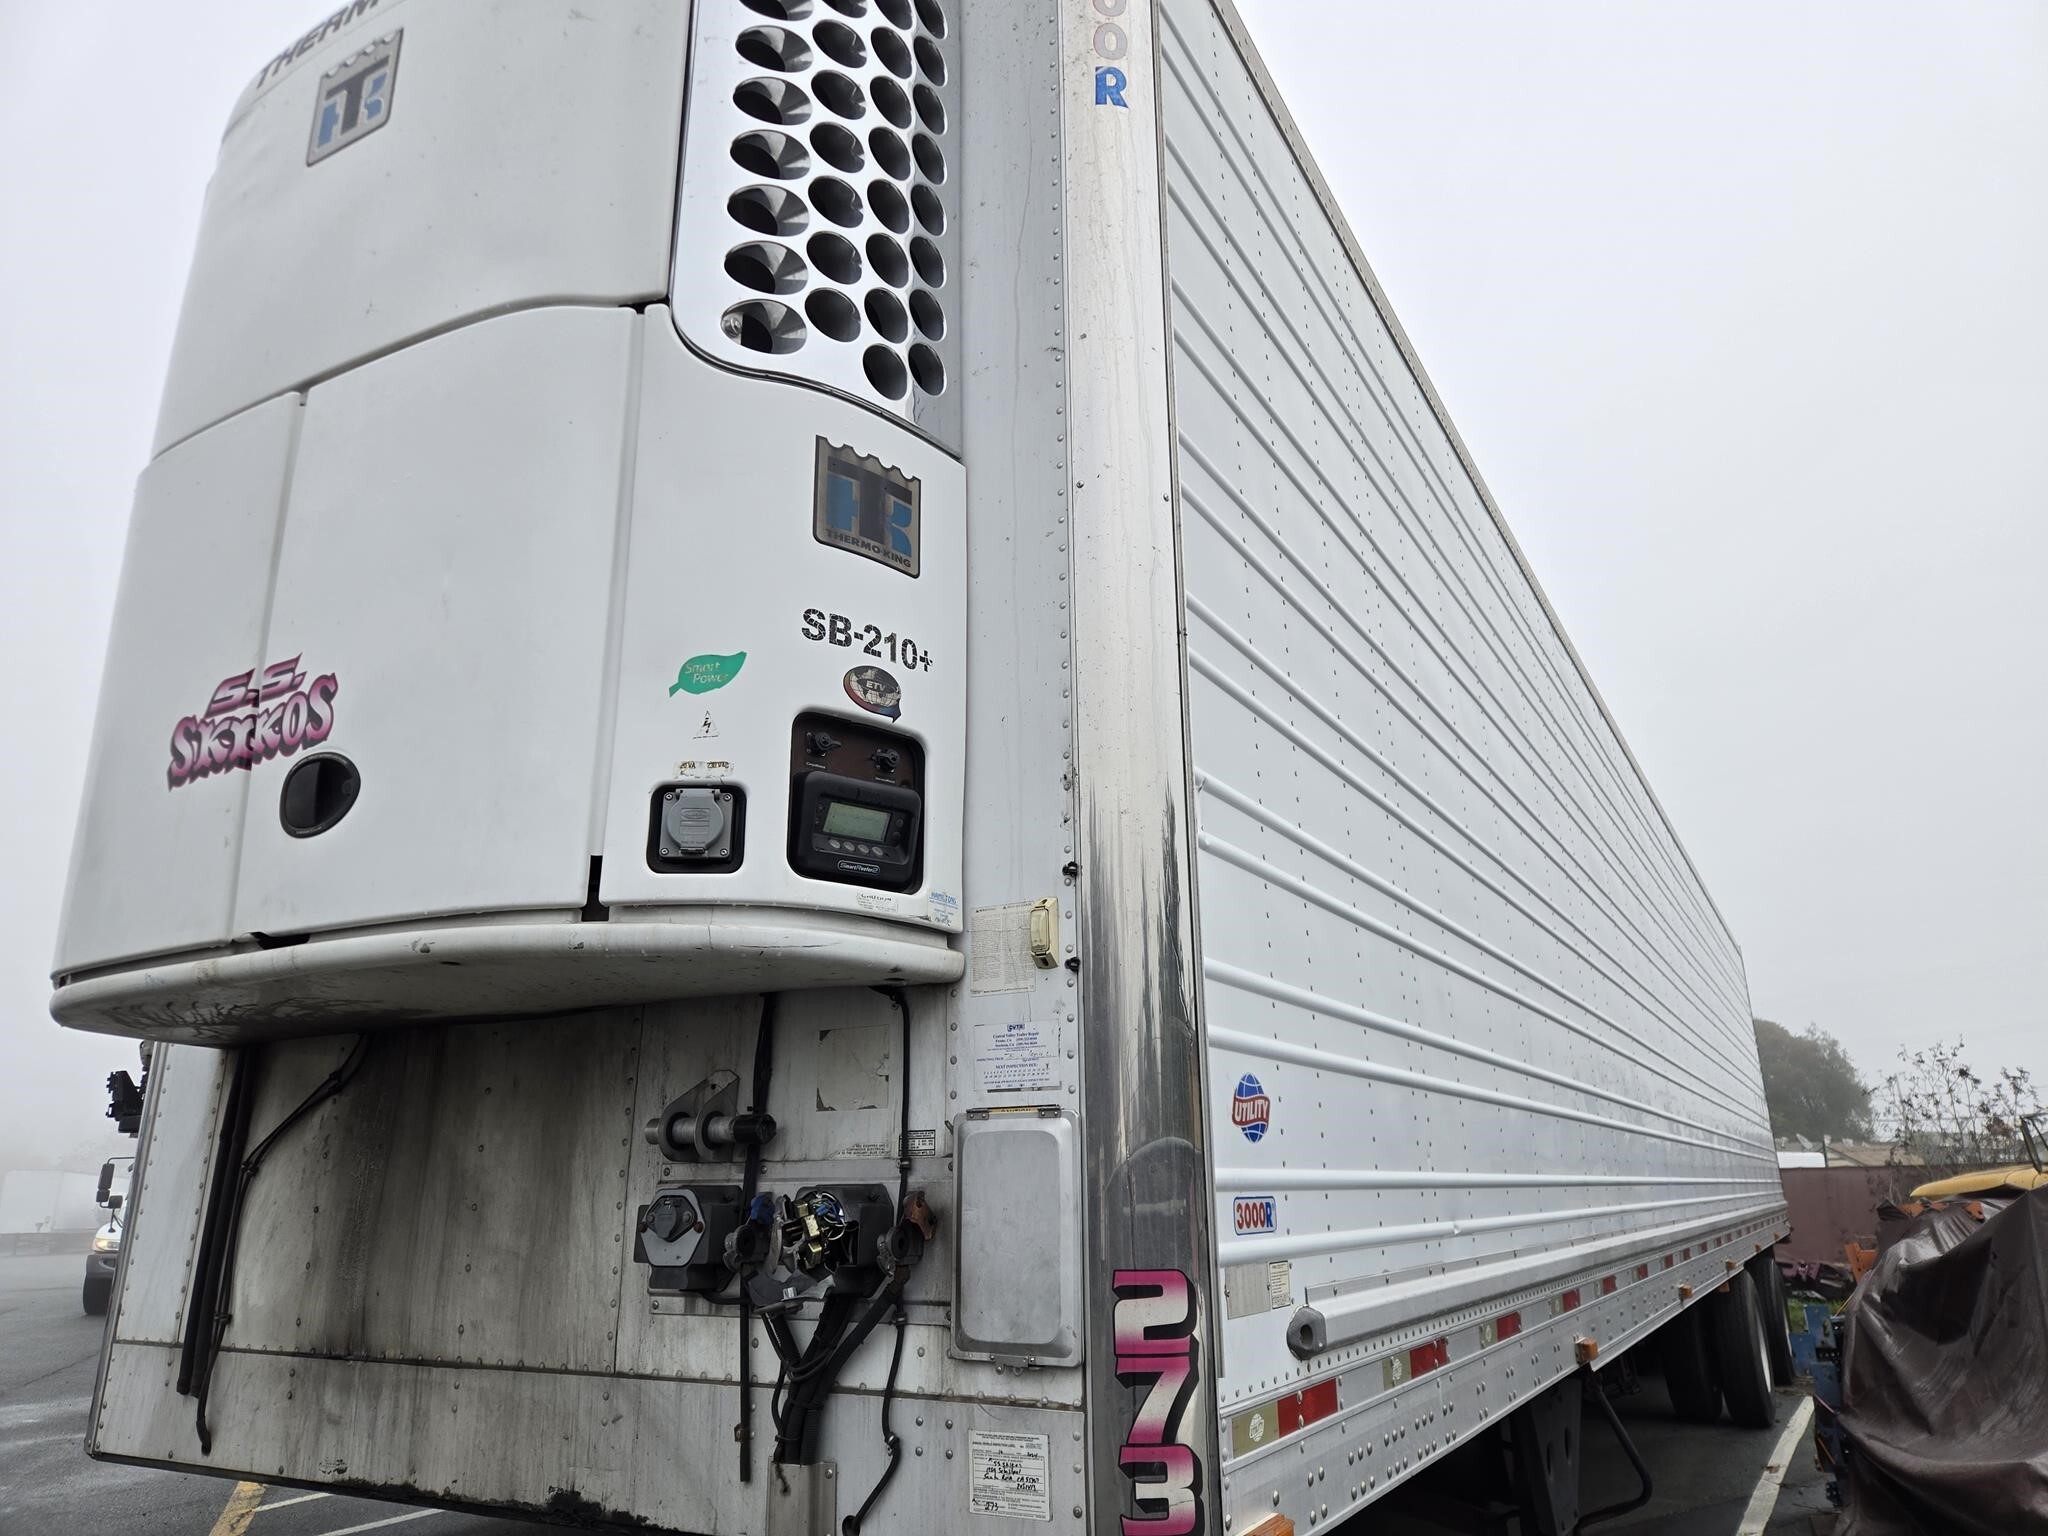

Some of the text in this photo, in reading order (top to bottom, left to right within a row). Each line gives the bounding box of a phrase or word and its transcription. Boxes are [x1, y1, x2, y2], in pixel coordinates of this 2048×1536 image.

[801, 608, 933, 672] SB-210+
[1234, 1099, 1269, 1122] UTILITY
[1236, 1201, 1274, 1229] 3000R
[1112, 1269, 1205, 1536] 273
